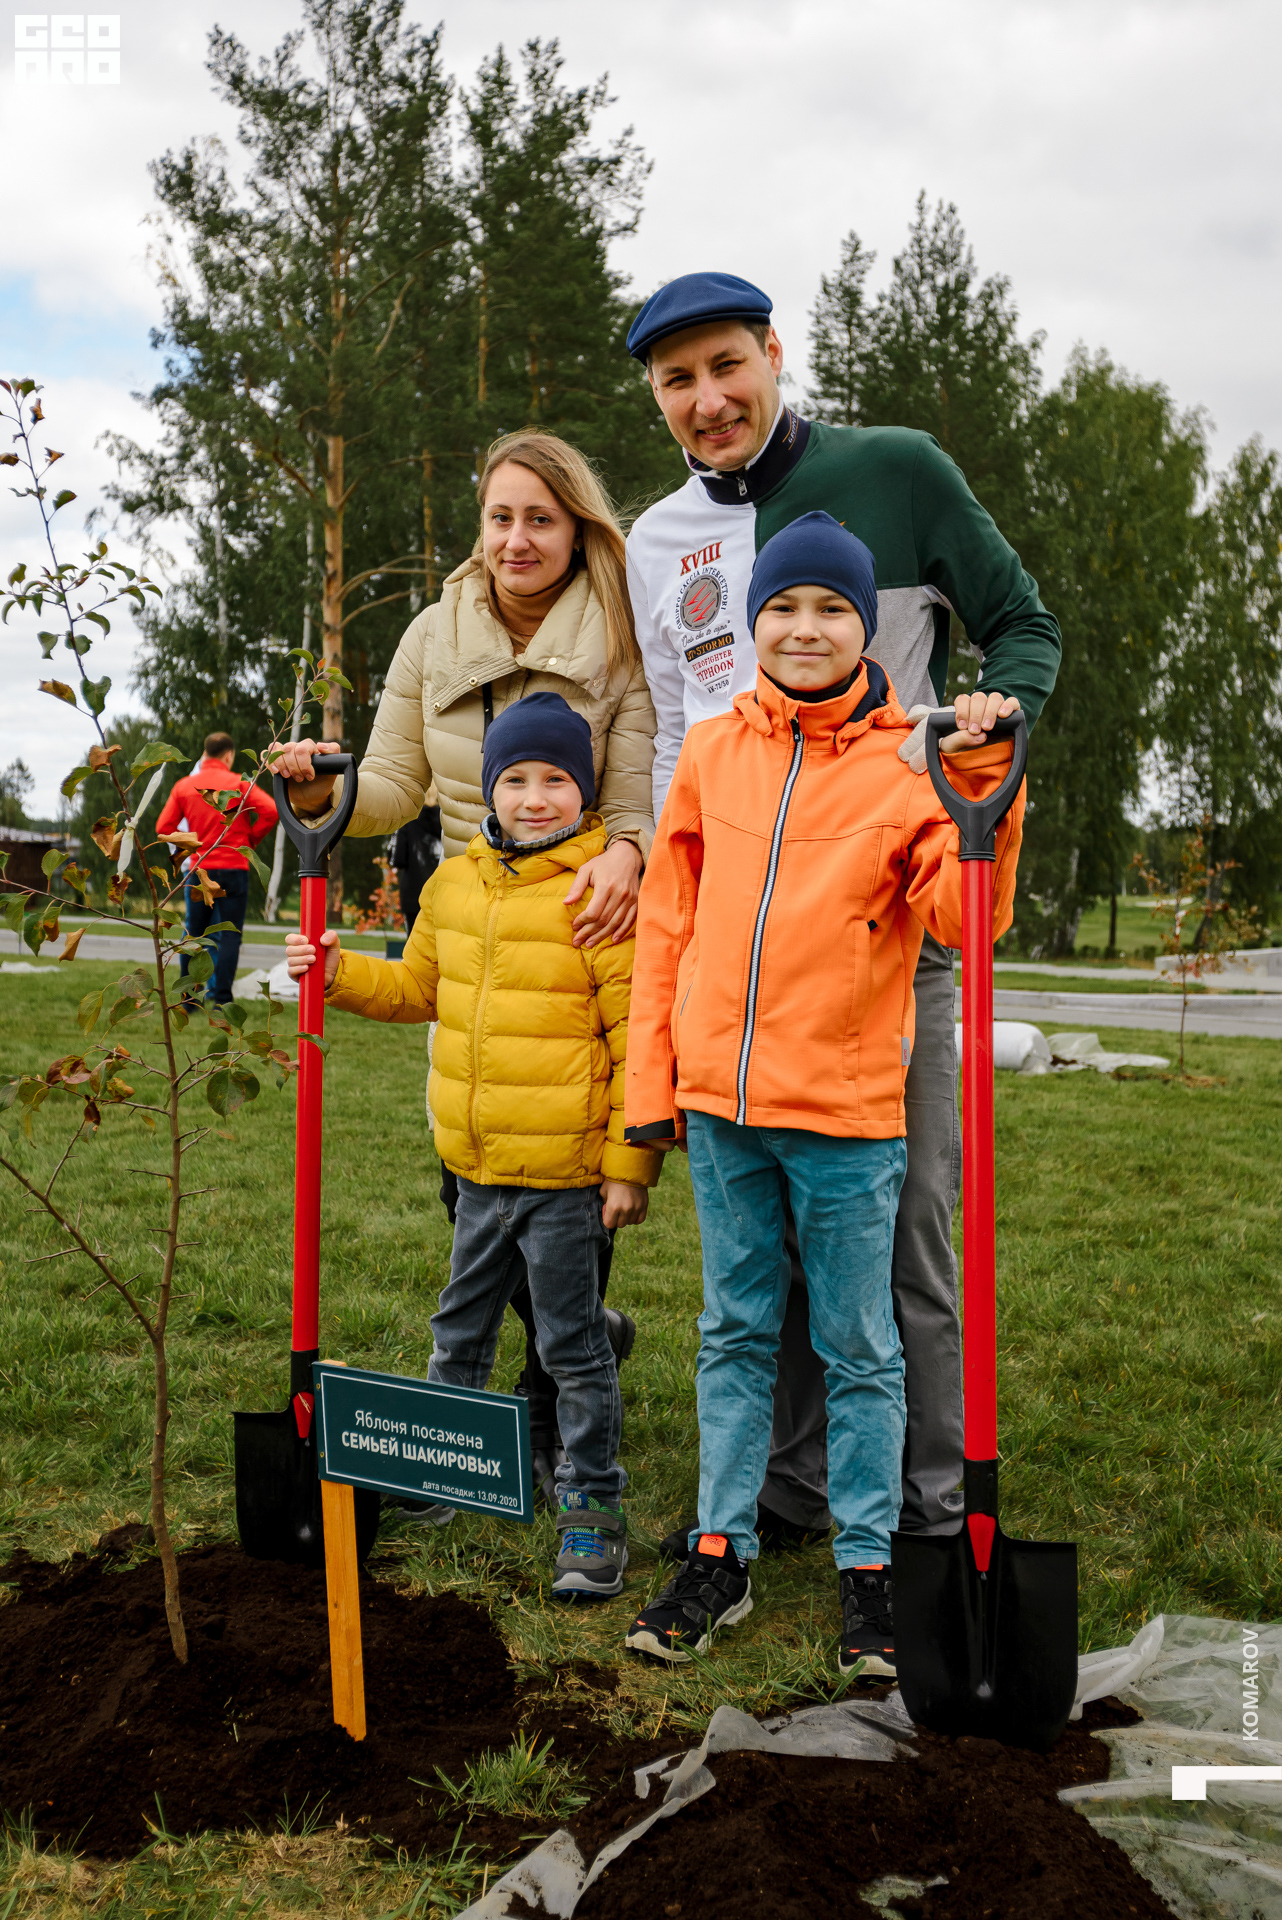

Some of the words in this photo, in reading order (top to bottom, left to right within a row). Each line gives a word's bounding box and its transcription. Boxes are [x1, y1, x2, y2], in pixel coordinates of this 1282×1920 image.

[680, 541, 722, 576] XVIII
[680, 570, 700, 594] CACCIA
[702, 567, 728, 610] INTERCETTORI
[692, 649, 732, 671] EUROFIGHTER
[695, 635, 733, 656] STORMO
[696, 658, 734, 682] TYPHOON
[355, 1409, 407, 1435] Яблоня
[411, 1424, 483, 1450] посажена
[341, 1431, 399, 1457] СЕМЬЕЙ
[402, 1442, 502, 1478] ШАКИРОВЫХ
[422, 1481, 440, 1491] дата
[441, 1484, 476, 1499] посадки:
[477, 1490, 518, 1508] 13.09.2020
